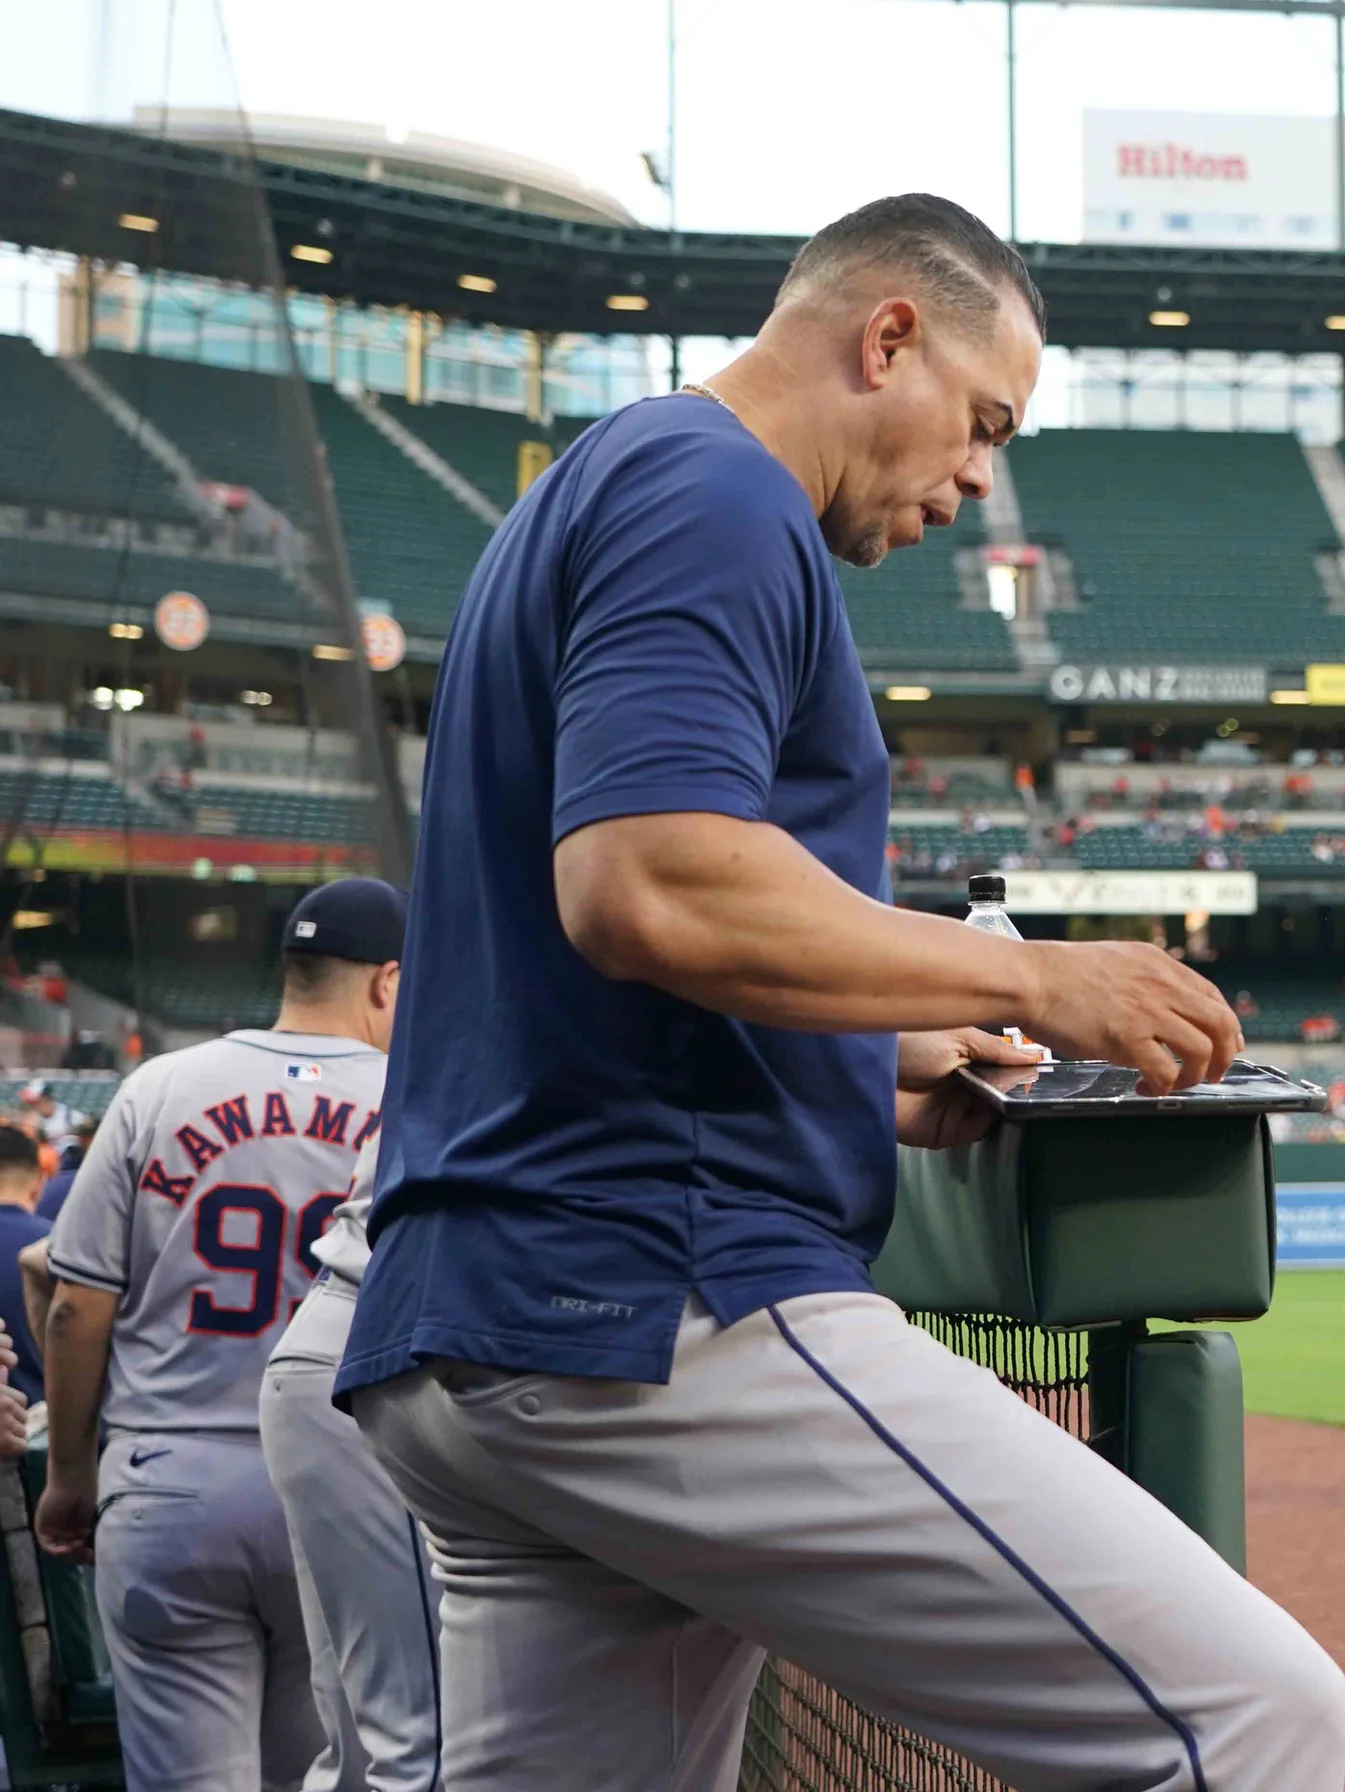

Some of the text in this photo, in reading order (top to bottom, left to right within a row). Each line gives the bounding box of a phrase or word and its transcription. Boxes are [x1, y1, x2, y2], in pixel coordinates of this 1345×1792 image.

[1117, 143, 1249, 182] Hilton
[1050, 664, 1180, 701] GANZ
[550, 1296, 638, 1317] DRI-FIT
